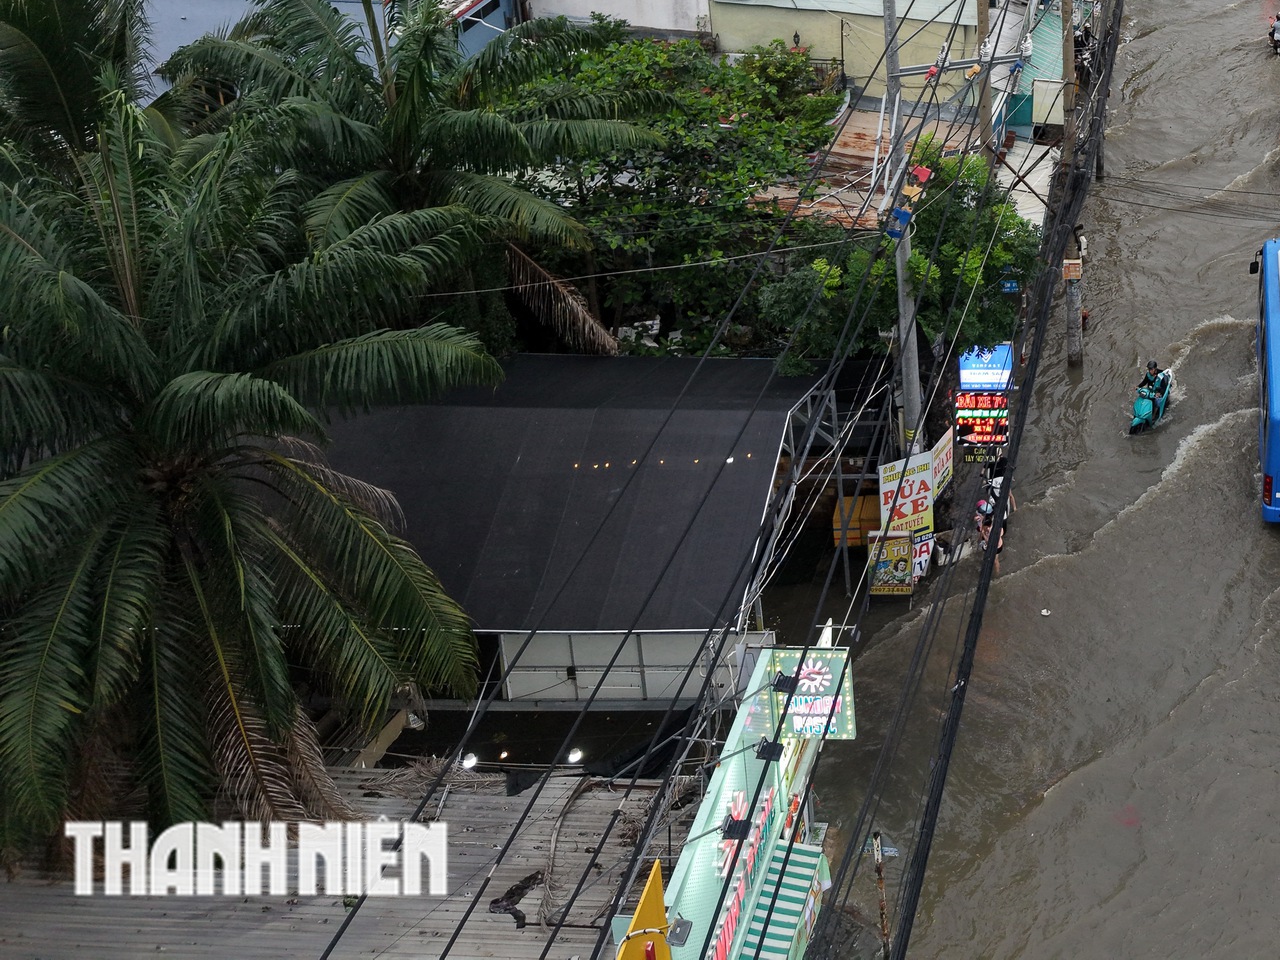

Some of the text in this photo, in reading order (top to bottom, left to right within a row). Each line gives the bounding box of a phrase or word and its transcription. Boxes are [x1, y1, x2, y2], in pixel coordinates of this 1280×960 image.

[882, 478, 931, 506] RỬA
[886, 496, 929, 523] XE
[783, 694, 843, 715] SUNDAY
